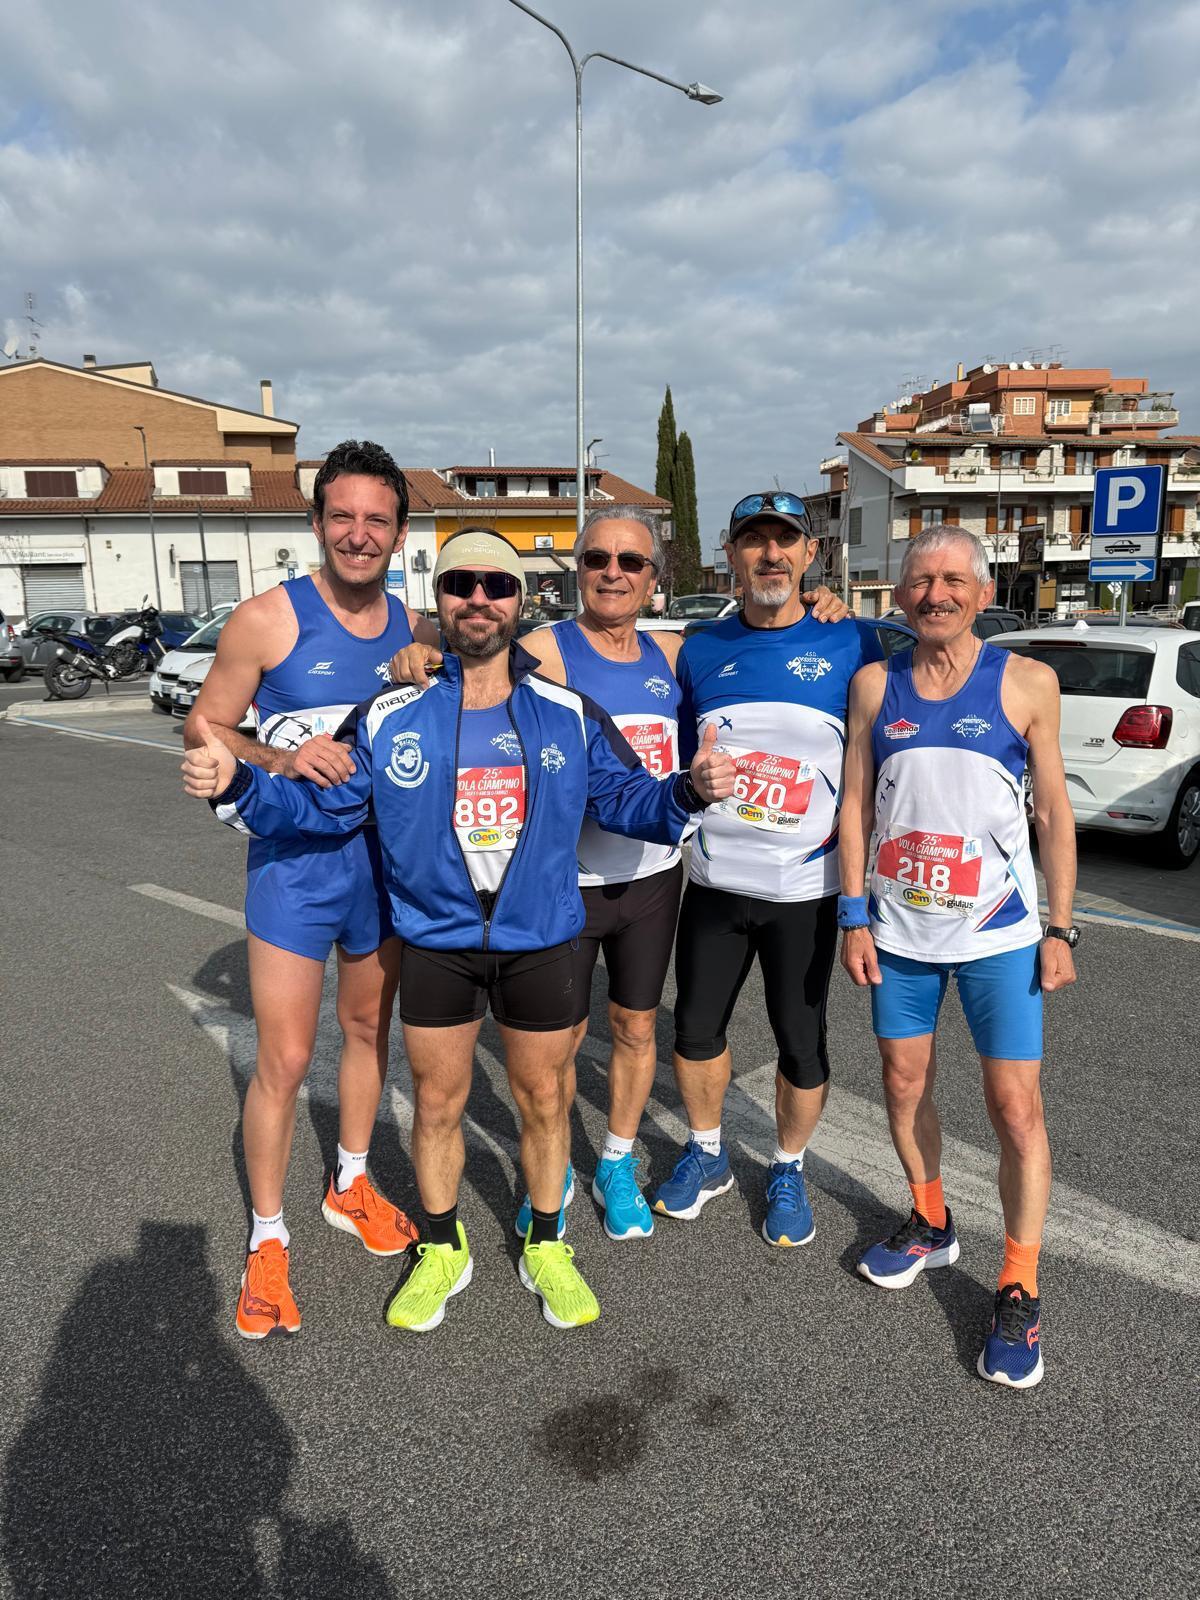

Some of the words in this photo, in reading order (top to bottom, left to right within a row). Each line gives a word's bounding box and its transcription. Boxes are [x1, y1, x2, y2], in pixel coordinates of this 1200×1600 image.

[1106, 476, 1146, 527] P
[376, 689, 422, 711] mape
[631, 733, 663, 746] CIAMPINO
[735, 758, 756, 770] VOLA
[756, 762, 795, 779] CIAMPINO
[477, 778, 520, 791] CIAMPINO
[733, 774, 787, 809] 670
[455, 796, 519, 827] 892
[740, 807, 763, 819] Dem
[472, 832, 500, 842] Dem
[898, 838, 915, 851] VOLA
[916, 844, 959, 859] CIAMPINO
[896, 856, 951, 892] 218
[907, 891, 930, 903] Dem
